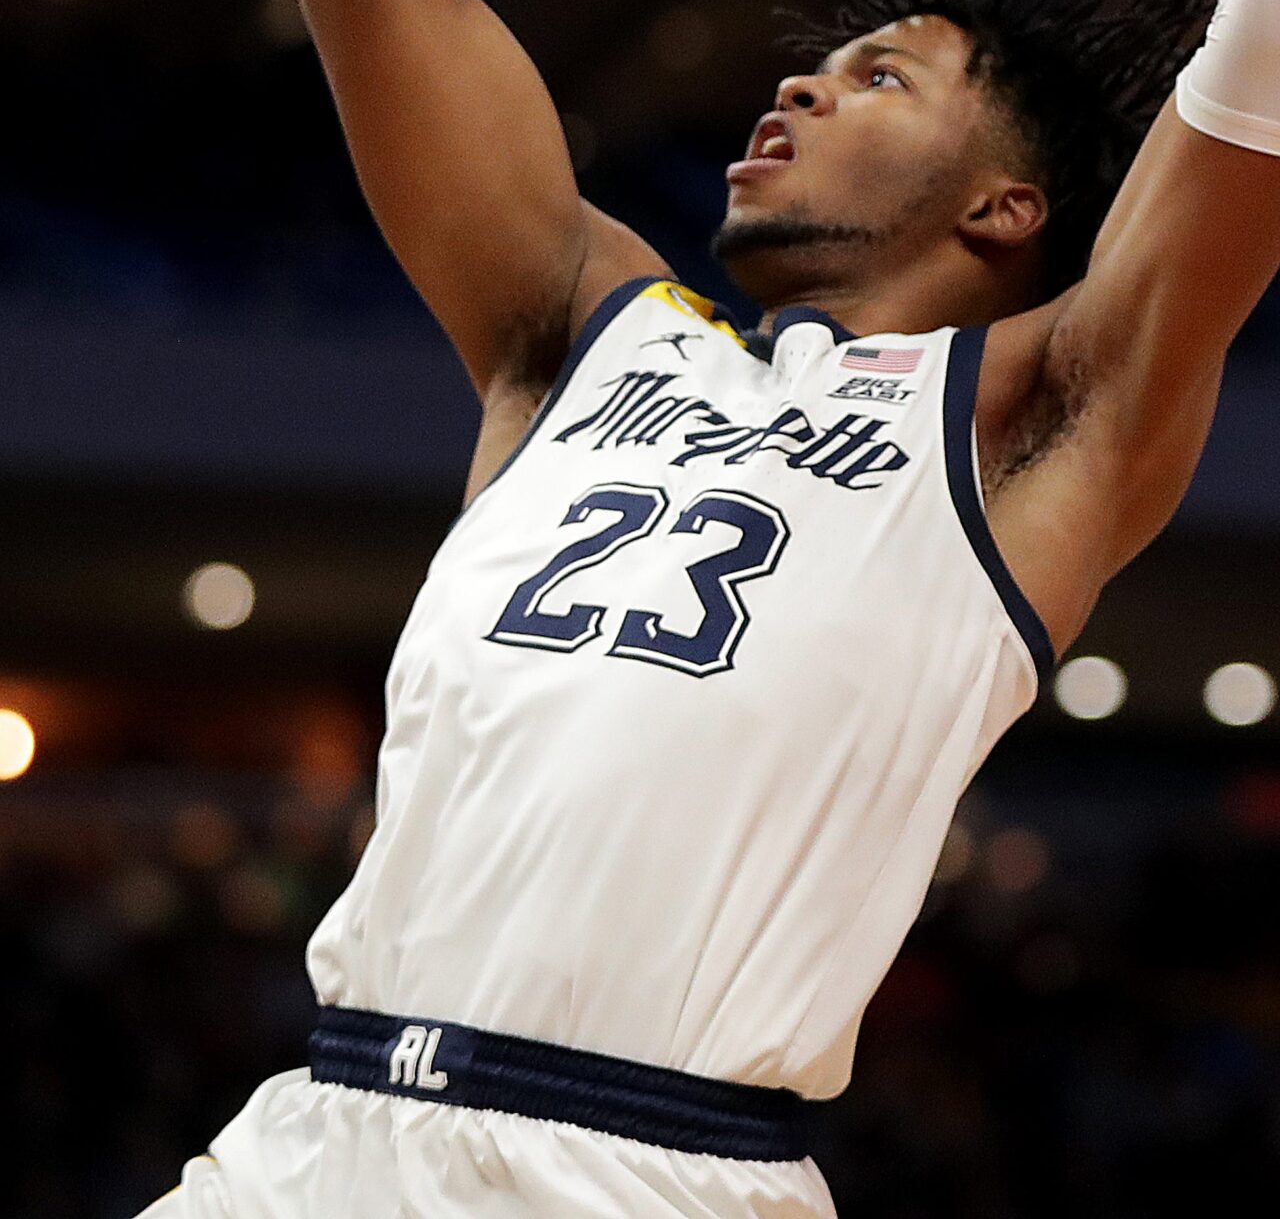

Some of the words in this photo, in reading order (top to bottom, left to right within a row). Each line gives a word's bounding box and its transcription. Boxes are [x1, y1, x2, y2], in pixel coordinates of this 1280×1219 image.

[551, 371, 910, 490] Marqette
[834, 385, 918, 401] EAST
[482, 482, 790, 678] 23
[389, 1025, 448, 1091] AL
